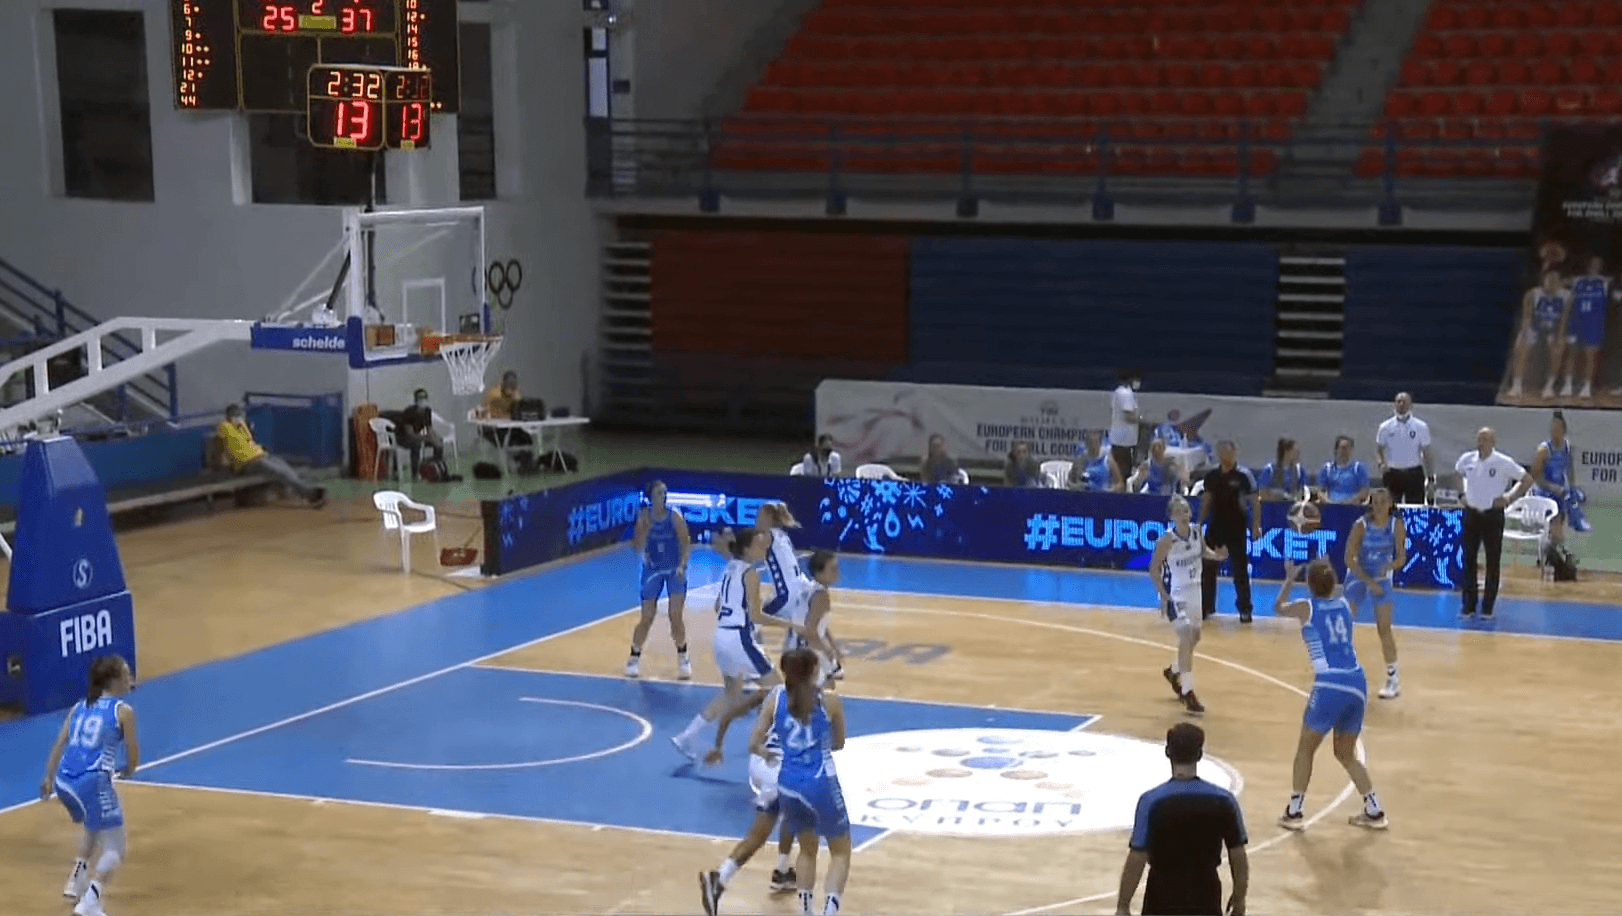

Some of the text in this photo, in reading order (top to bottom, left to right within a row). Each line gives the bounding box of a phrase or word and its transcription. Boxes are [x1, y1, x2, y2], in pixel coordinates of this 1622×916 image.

[263, 5, 295, 31] 25
[342, 7, 371, 32] 37
[181, 43, 194, 55] 10
[182, 56, 194, 67] 11
[180, 81, 195, 93] 21
[183, 69, 195, 81] 12
[327, 71, 380, 99] 2:32
[180, 94, 196, 106] 44
[336, 101, 369, 139] 13
[402, 103, 422, 140] 13
[292, 333, 346, 350] schelde
[59, 608, 113, 658] FIBA
[1324, 613, 1350, 644] 14
[69, 714, 104, 748] 19
[783, 714, 819, 750] 21
